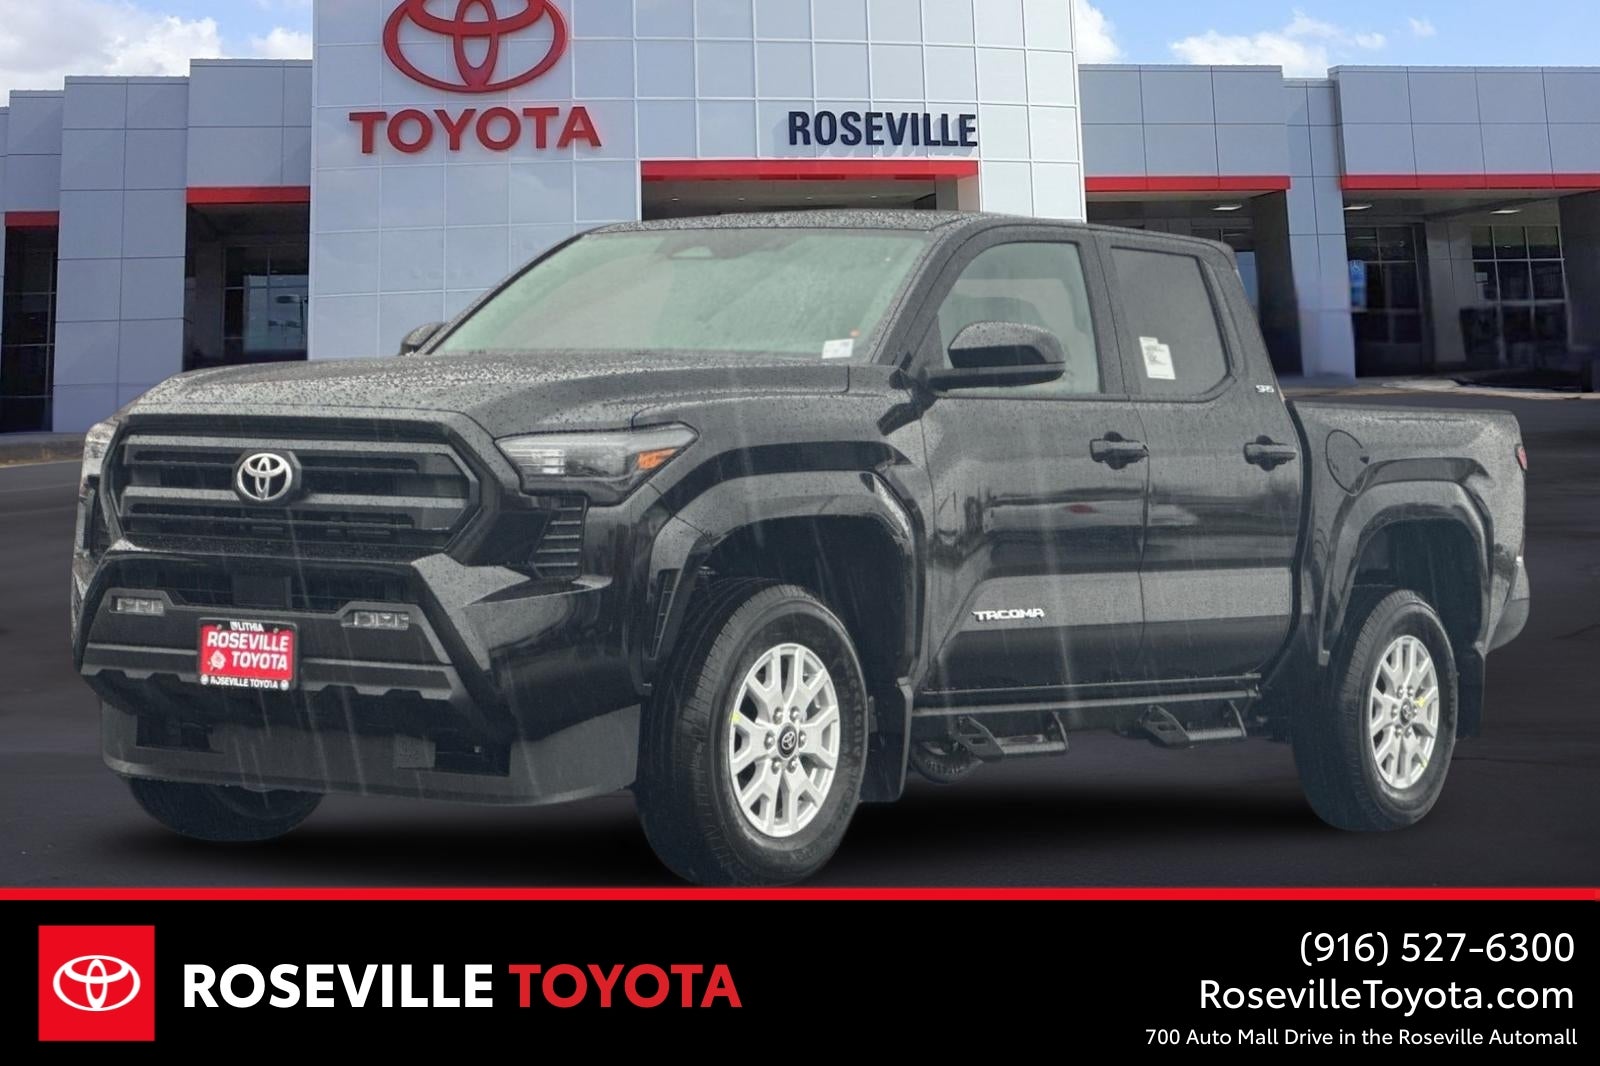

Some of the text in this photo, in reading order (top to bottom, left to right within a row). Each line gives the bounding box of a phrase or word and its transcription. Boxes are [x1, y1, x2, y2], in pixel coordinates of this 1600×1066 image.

[349, 106, 602, 154] TOYOTA
[788, 110, 979, 147] ROSEVILLE
[972, 607, 1046, 622] TACOMA
[207, 631, 290, 653] ROSEVILLE
[231, 651, 288, 671] TOYOTA
